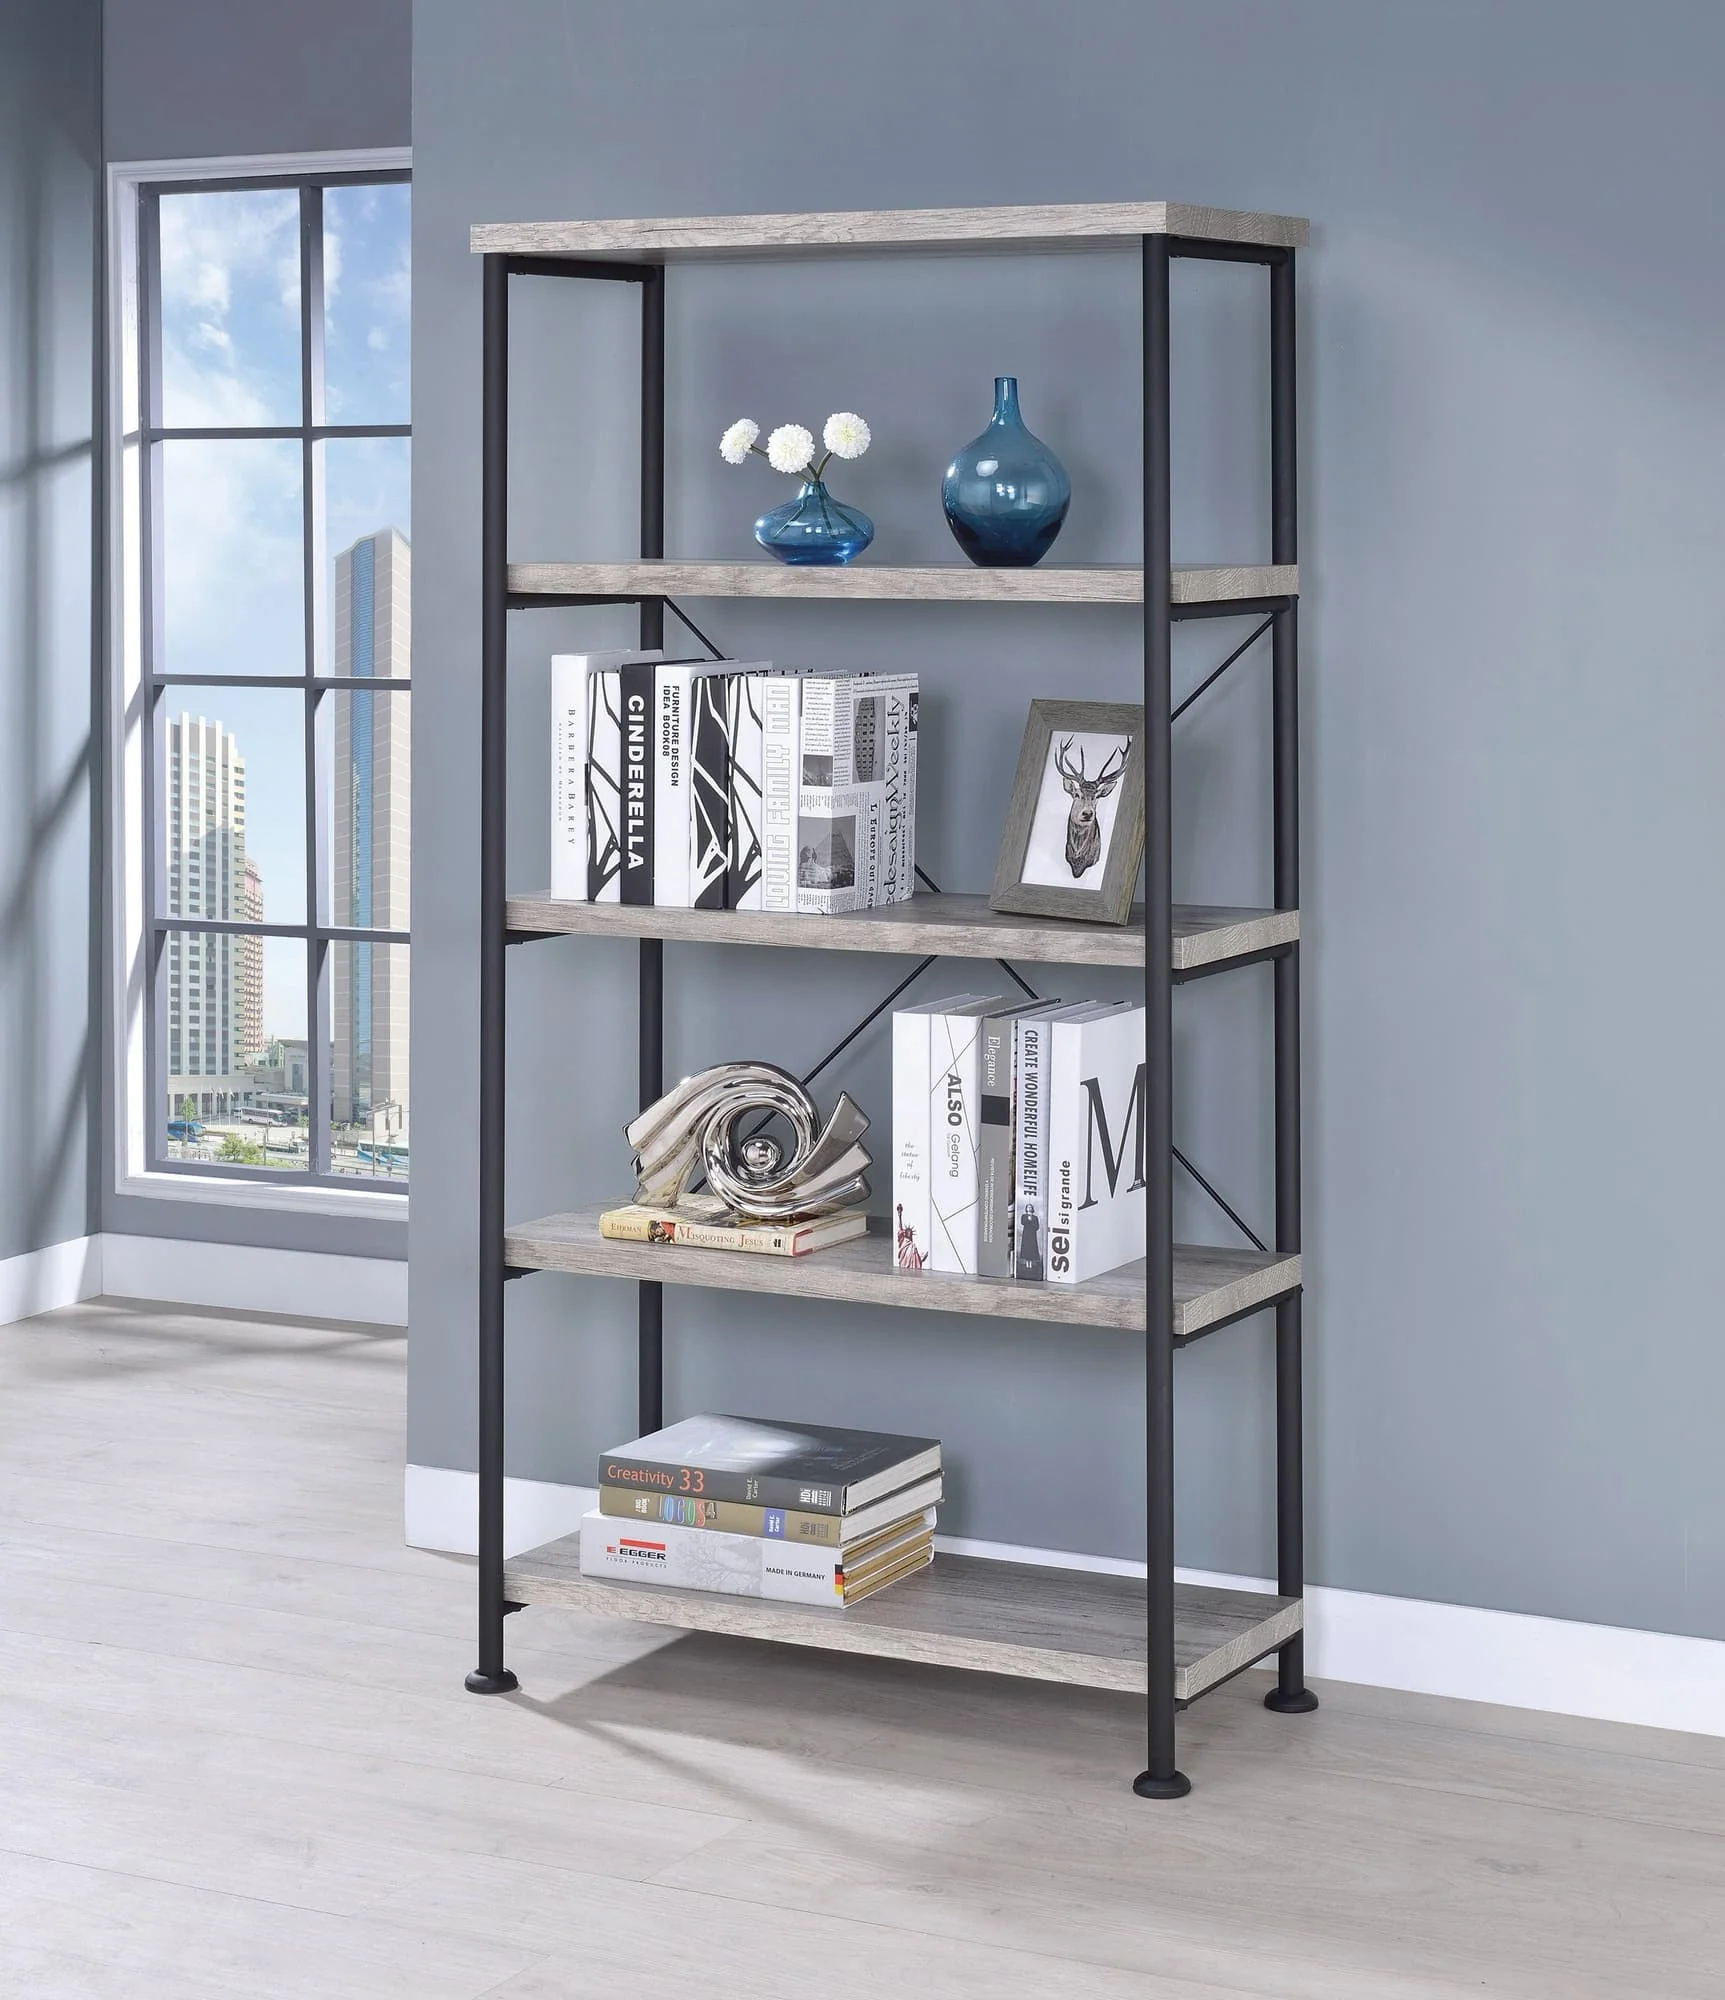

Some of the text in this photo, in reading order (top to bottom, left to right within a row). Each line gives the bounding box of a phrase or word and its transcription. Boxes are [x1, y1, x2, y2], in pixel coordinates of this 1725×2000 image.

[662, 685, 671, 757] IDEA BOOK08
[671, 685, 680, 787] FURNITURE DESIGN
[766, 684, 790, 735] MAN
[627, 694, 645, 870] CINDERELLA
[766, 743, 790, 825] FAMILY
[983, 1035, 1000, 1087] Elegance
[947, 1072, 962, 1178] ALSO Gelang
[1023, 1029, 1039, 1197] CREATE WONDERFUL HOMELIFE
[1077, 1062, 1147, 1211] M
[1048, 1160, 1073, 1273] sei si grande
[607, 1464, 704, 1492] Creativity 33
[619, 1547, 666, 1561] EGGER
[765, 1567, 784, 1575] MADE
[793, 1570, 825, 1580] GERMANY
